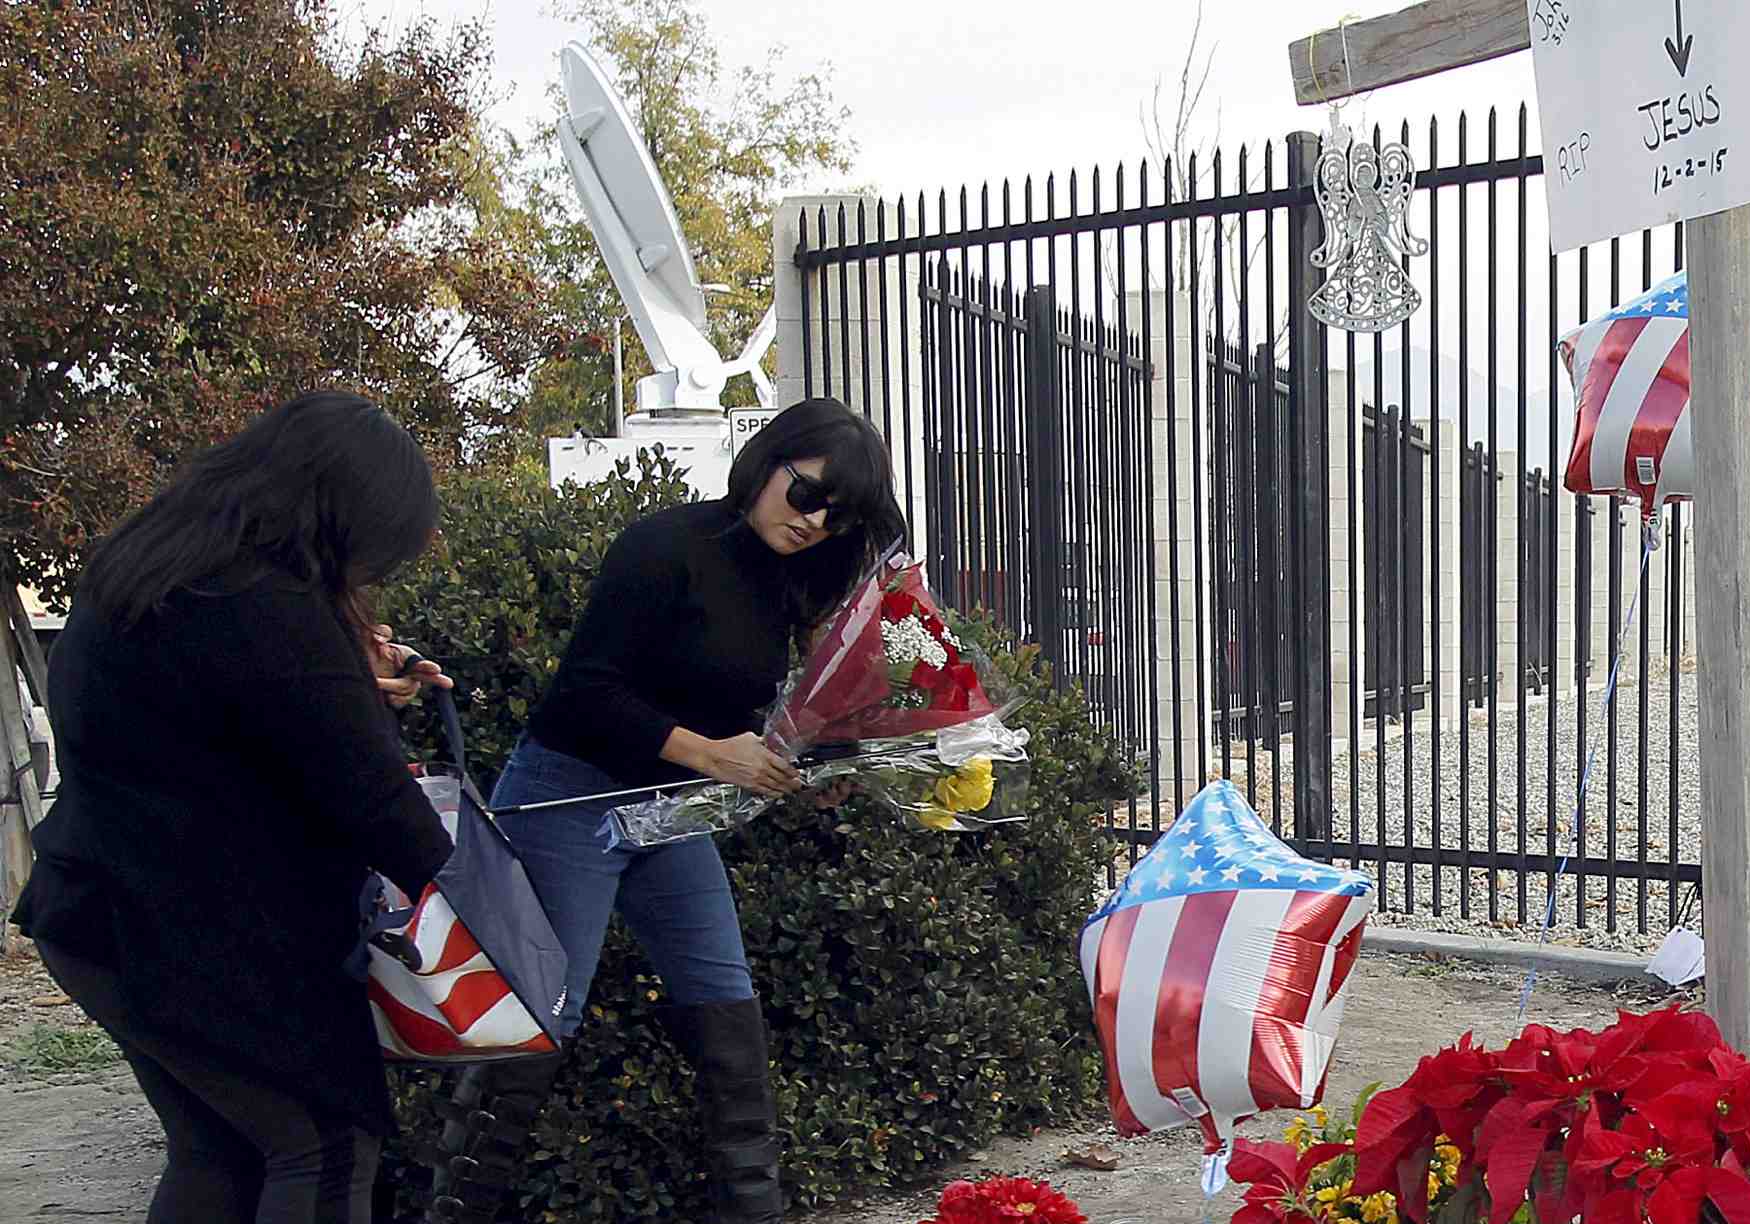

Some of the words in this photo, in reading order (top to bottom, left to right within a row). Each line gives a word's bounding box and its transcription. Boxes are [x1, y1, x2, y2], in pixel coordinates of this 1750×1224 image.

[1552, 13, 1569, 45] 3:16
[1638, 84, 1720, 151] JESUS
[1558, 132, 1590, 187] RIP
[1654, 147, 1728, 195] 12-2-15
[737, 417, 770, 432] SPE
